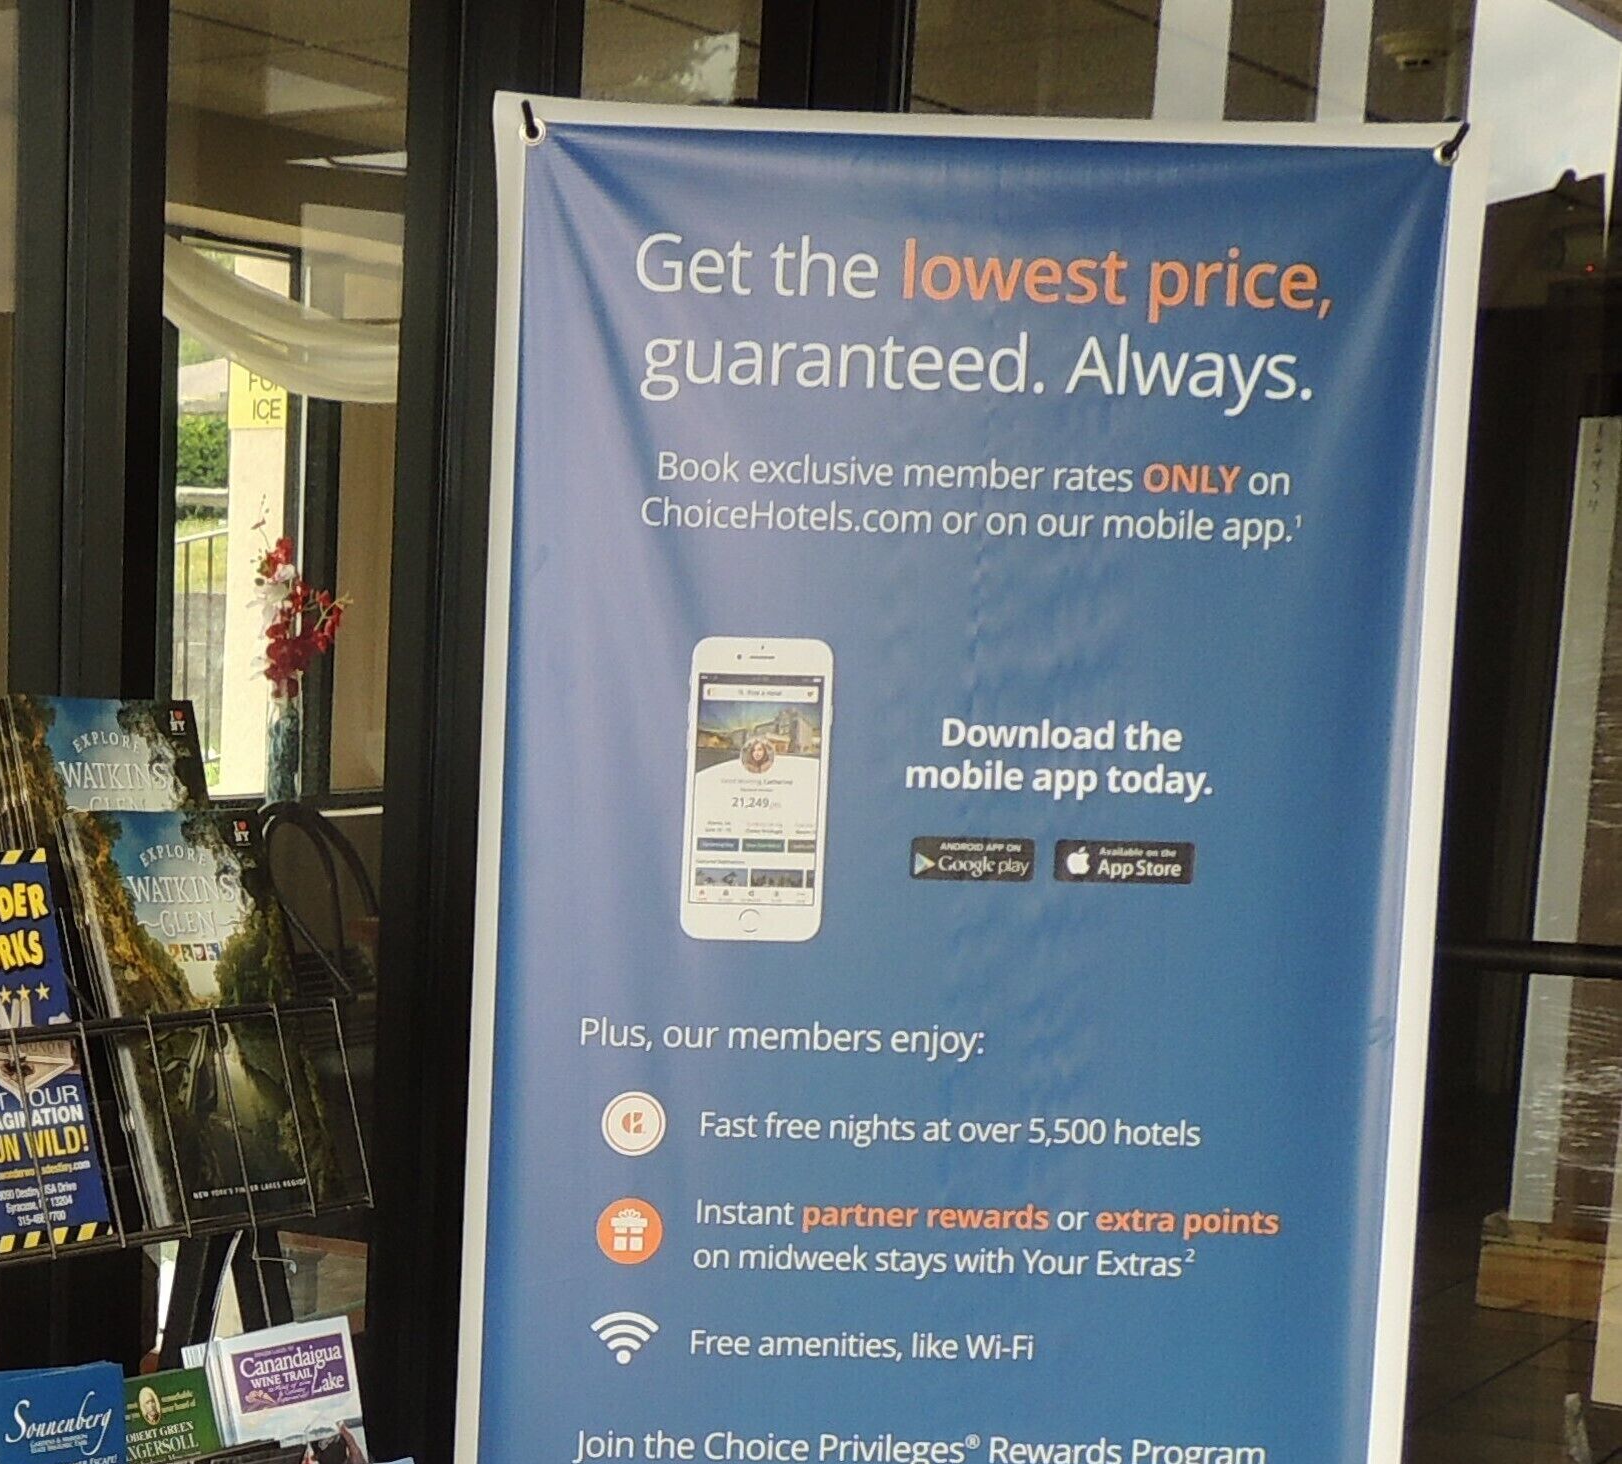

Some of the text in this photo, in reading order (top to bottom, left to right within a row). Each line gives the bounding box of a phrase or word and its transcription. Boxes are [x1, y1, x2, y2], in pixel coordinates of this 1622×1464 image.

[636, 232, 1332, 322] Get the lowest price,
[249, 371, 281, 391] FO
[639, 332, 1313, 416] guaranteed. Always.
[252, 398, 282, 420] ICE
[658, 451, 1290, 496] Book exclusive member rates ONLY on
[941, 717, 1183, 752] Download the
[905, 759, 1213, 802] mobile app today.
[940, 841, 982, 852] ANDROID
[986, 842, 1005, 852] APP
[1144, 849, 1157, 857] on
[1161, 848, 1176, 858] the
[938, 854, 1029, 878] Google play
[1098, 859, 1181, 879] App Store
[579, 1018, 986, 1062] Plus, our members enjoy:
[700, 1111, 1200, 1148] Fast free nights at over 5,500 hotels
[696, 1199, 1279, 1239] Instant partner rewards or extra points
[239, 1343, 343, 1378] Canandaigua
